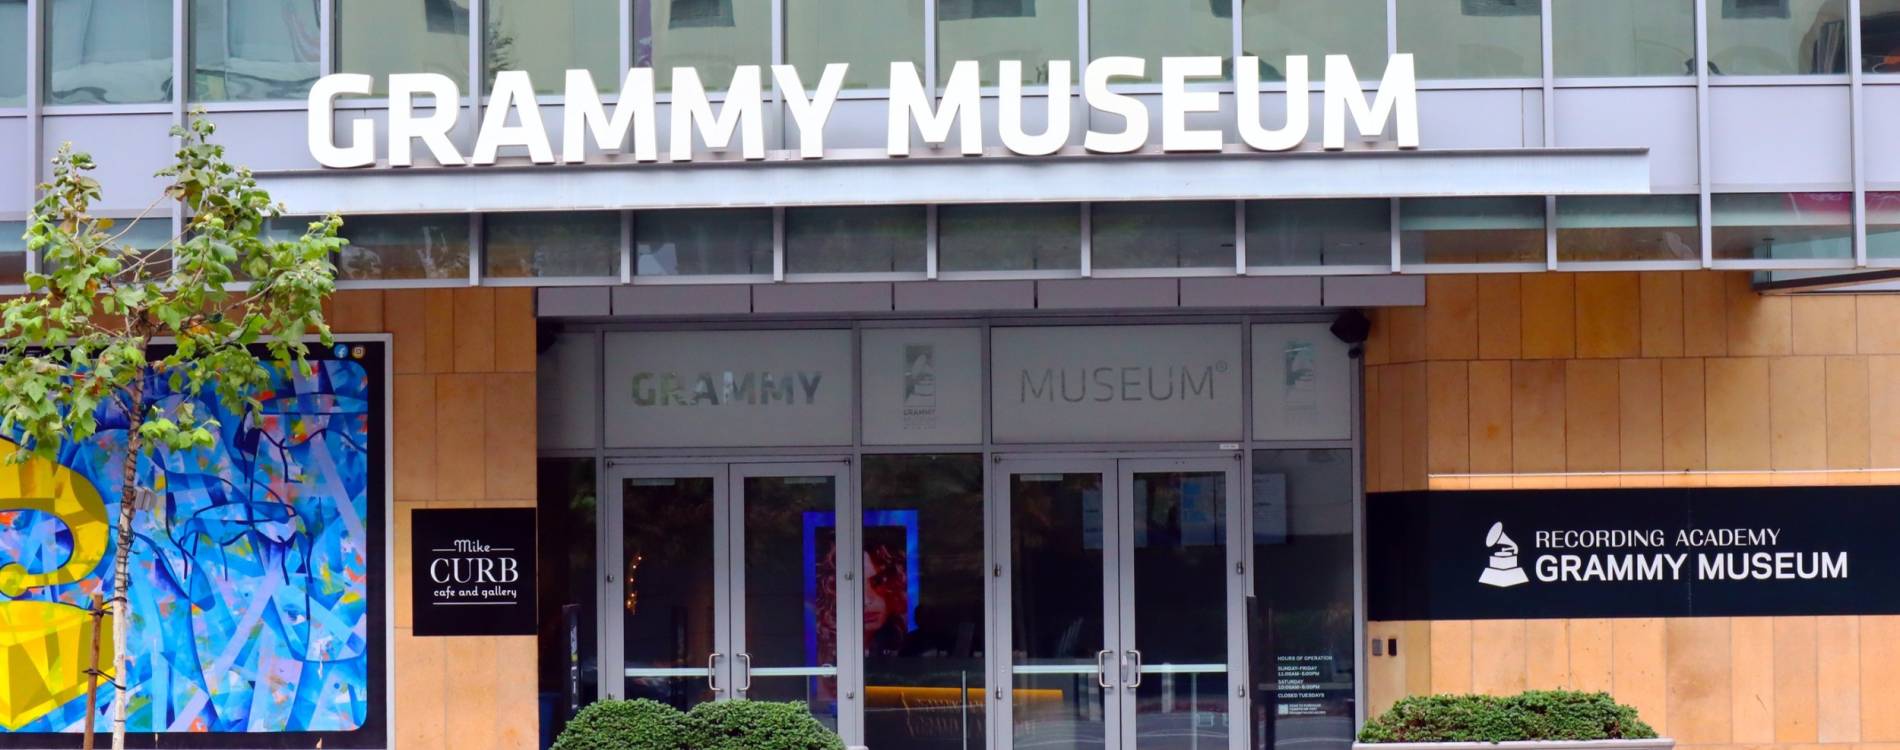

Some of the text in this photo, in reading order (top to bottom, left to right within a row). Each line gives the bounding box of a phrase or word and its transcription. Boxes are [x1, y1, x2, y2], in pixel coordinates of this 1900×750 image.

[307, 53, 1419, 168] GRAMMY MUSEUM
[631, 370, 823, 407] GRAMMY
[453, 539, 491, 553] Mike
[1535, 527, 1782, 549] RECORDING ACADEMY
[430, 557, 519, 584] CURB
[1535, 550, 1849, 583] GRAMMY MUSEUM
[433, 585, 517, 599] cafe and gallery
